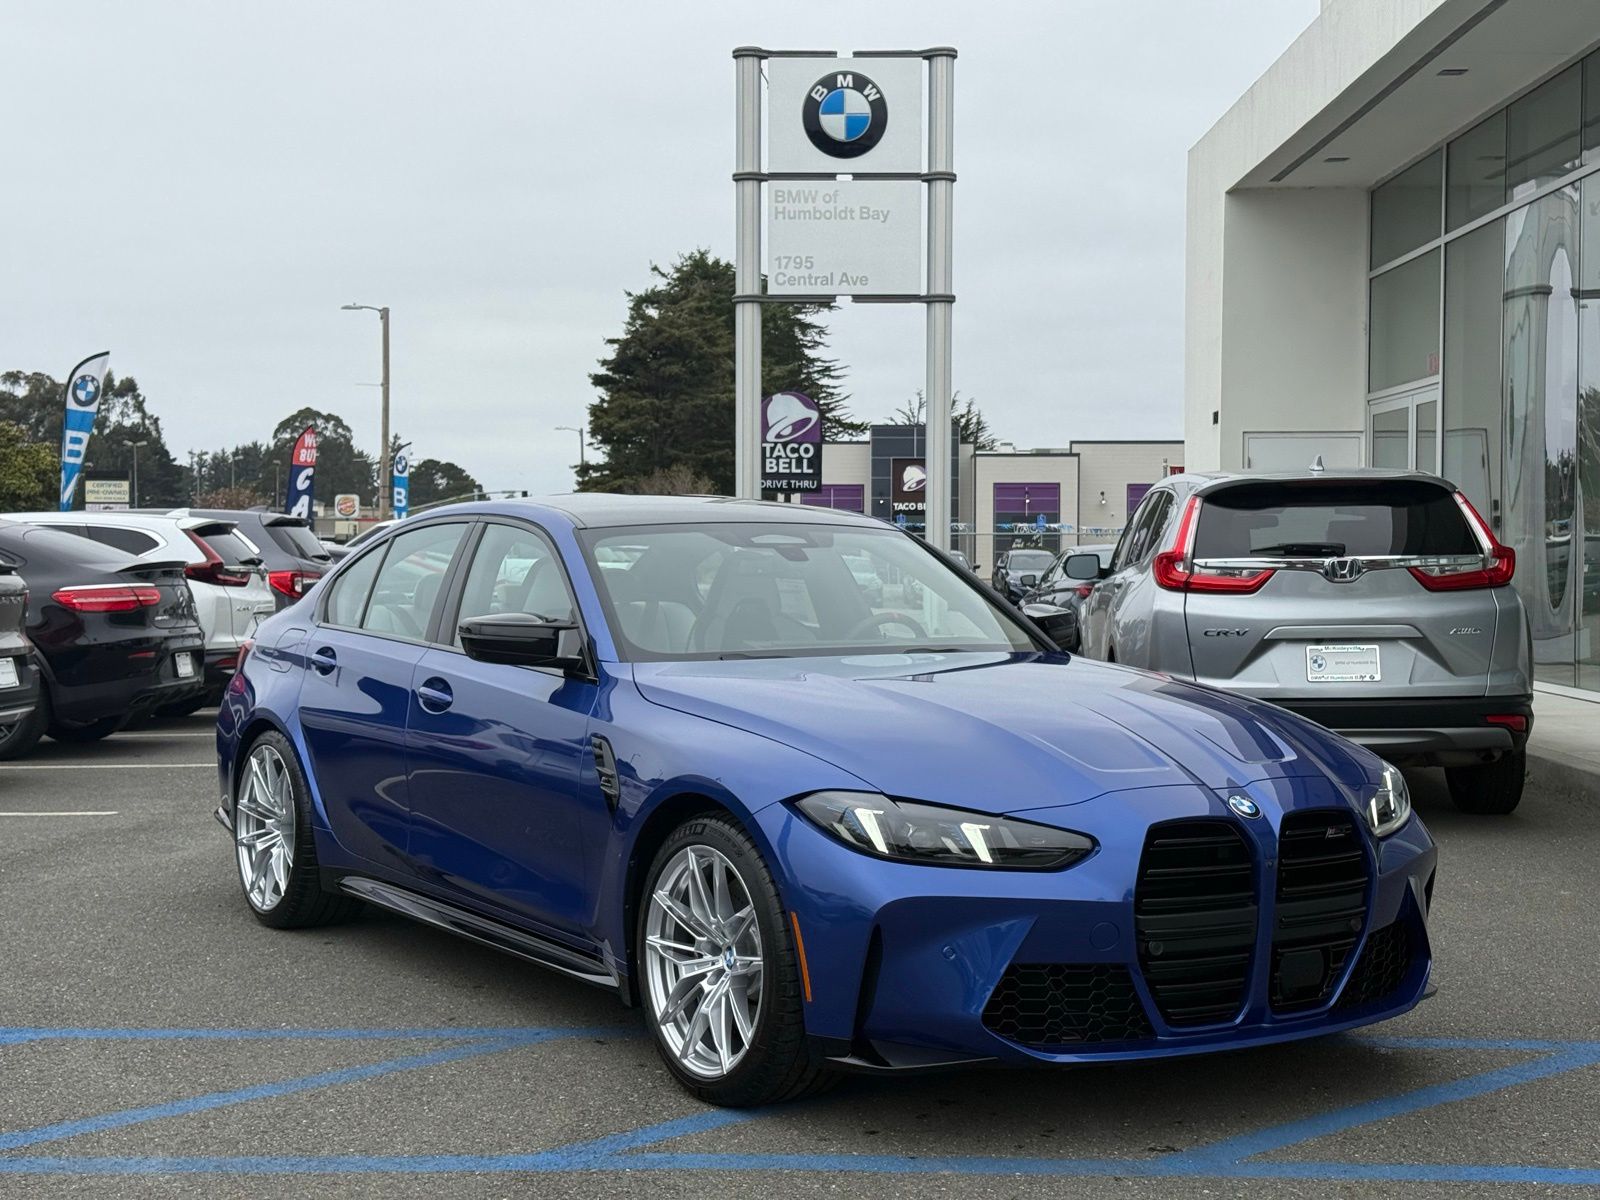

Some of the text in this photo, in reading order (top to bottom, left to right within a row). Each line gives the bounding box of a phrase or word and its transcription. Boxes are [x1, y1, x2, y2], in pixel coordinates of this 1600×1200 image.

[810, 74, 881, 103] BMW
[774, 189, 840, 204] BMW of
[774, 206, 890, 223] Humboldt Bay
[774, 255, 814, 270] 1795
[774, 271, 869, 286] Central Ave
[761, 443, 814, 459] TACO
[765, 458, 814, 474] BELL
[760, 480, 817, 489] DRIVE THRU
[893, 502, 916, 511] TACO
[1203, 629, 1249, 637] CR-V
